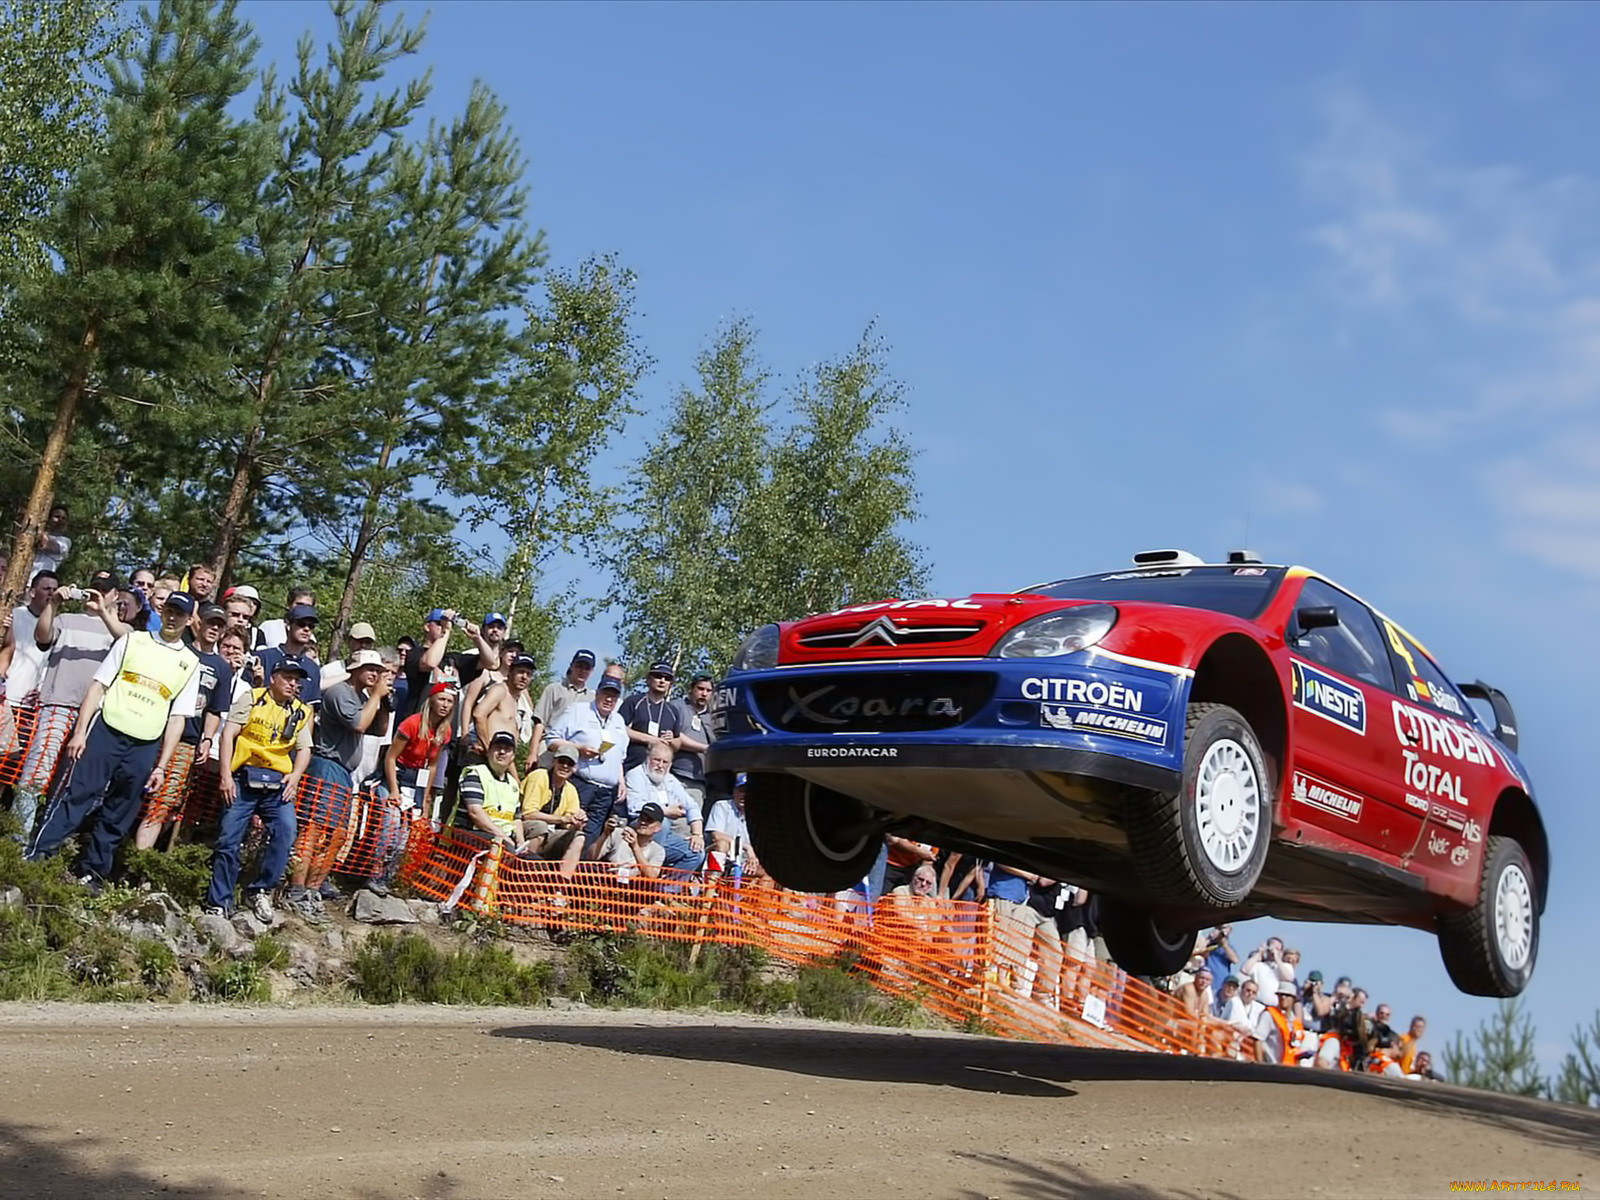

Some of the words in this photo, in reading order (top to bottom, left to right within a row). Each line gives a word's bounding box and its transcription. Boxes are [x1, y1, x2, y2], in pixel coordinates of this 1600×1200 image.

[781, 685, 963, 724] Xsara
[1021, 677, 1142, 712] CITROËN
[1314, 680, 1359, 722] NESTE
[1075, 712, 1164, 738] MICHELIN
[807, 748, 898, 757] EURODATACAR
[1402, 749, 1468, 806] TOTAL
[1308, 785, 1361, 815] MICHELIN
